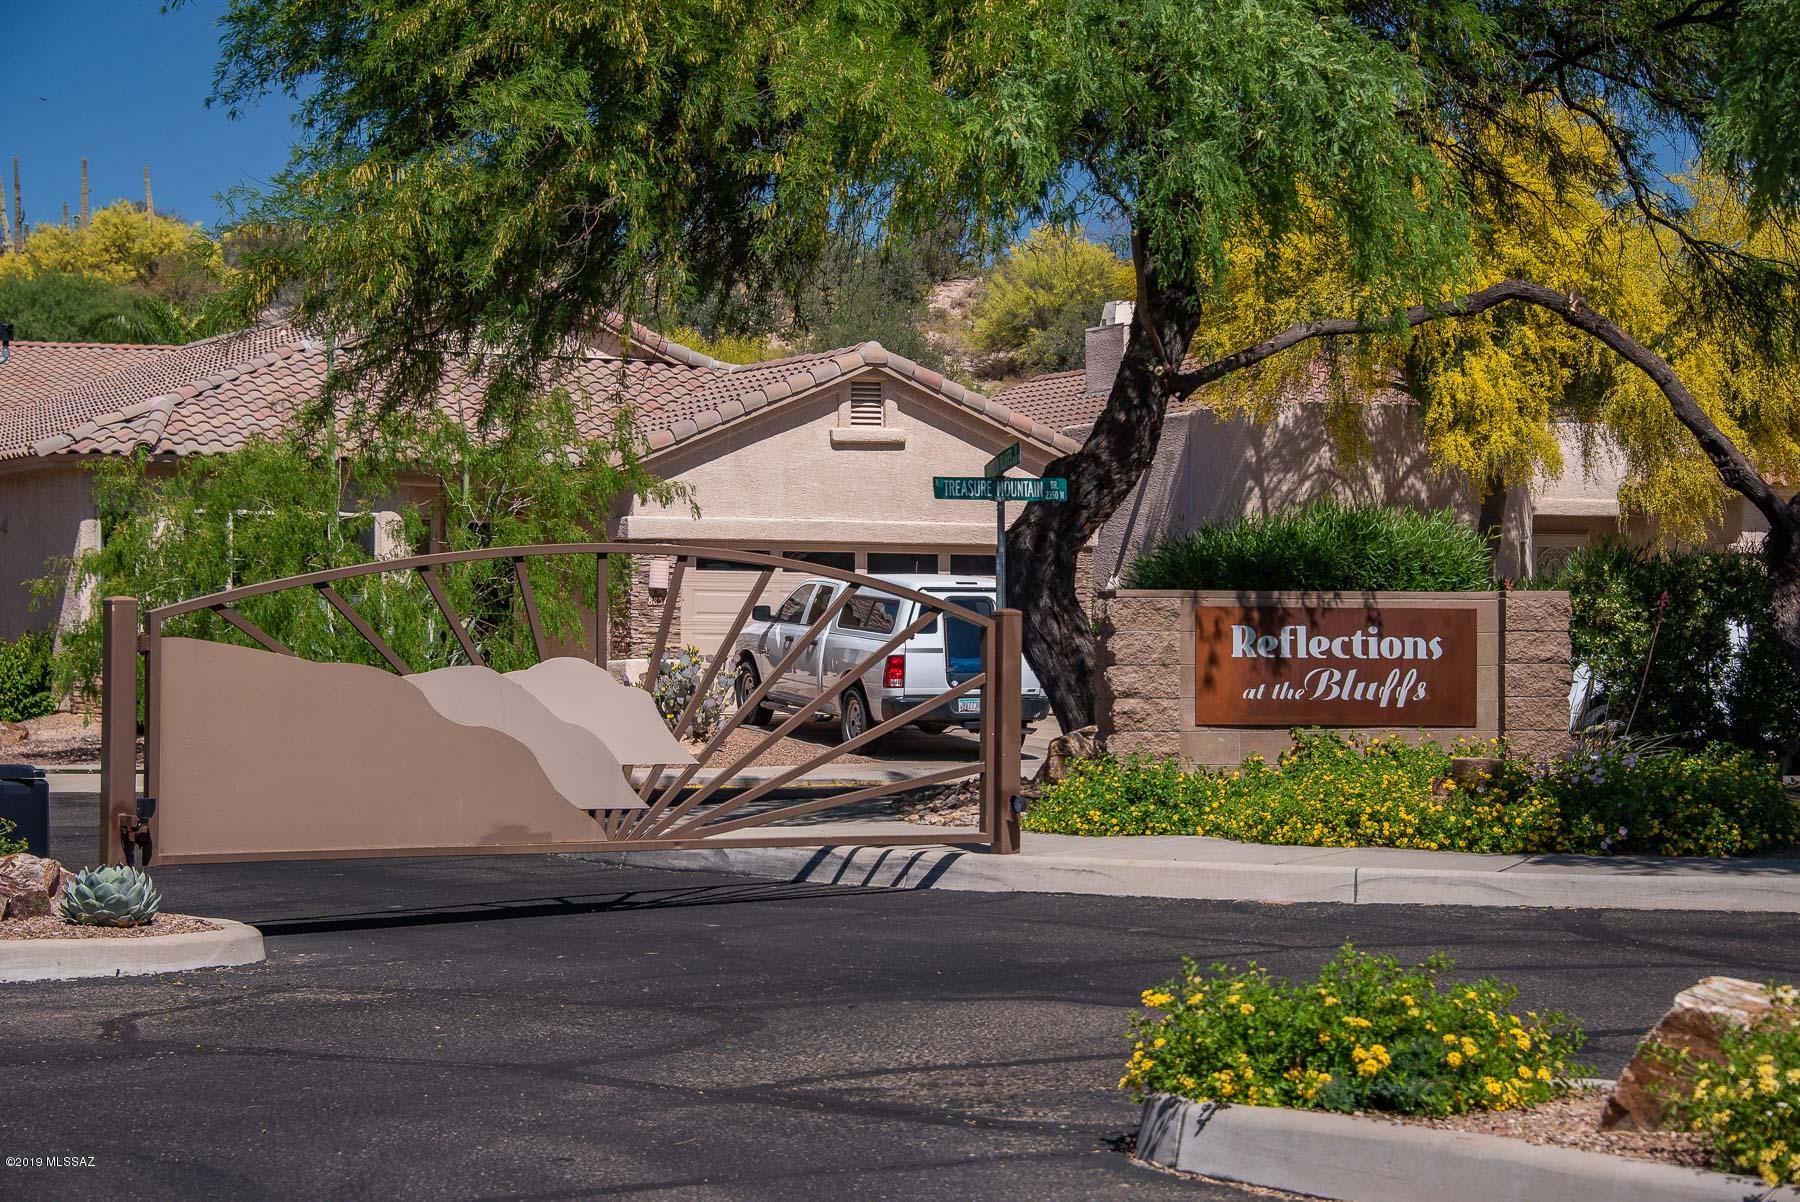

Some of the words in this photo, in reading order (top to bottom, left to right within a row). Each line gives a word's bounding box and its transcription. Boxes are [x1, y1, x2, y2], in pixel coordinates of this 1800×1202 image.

[944, 480, 992, 497] TREASURE
[997, 480, 1043, 498] MOUNTAIN
[1231, 625, 1443, 660] Reflections
[1242, 683, 1265, 700] at
[1272, 681, 1305, 700] the
[1304, 667, 1427, 708] Bluffs
